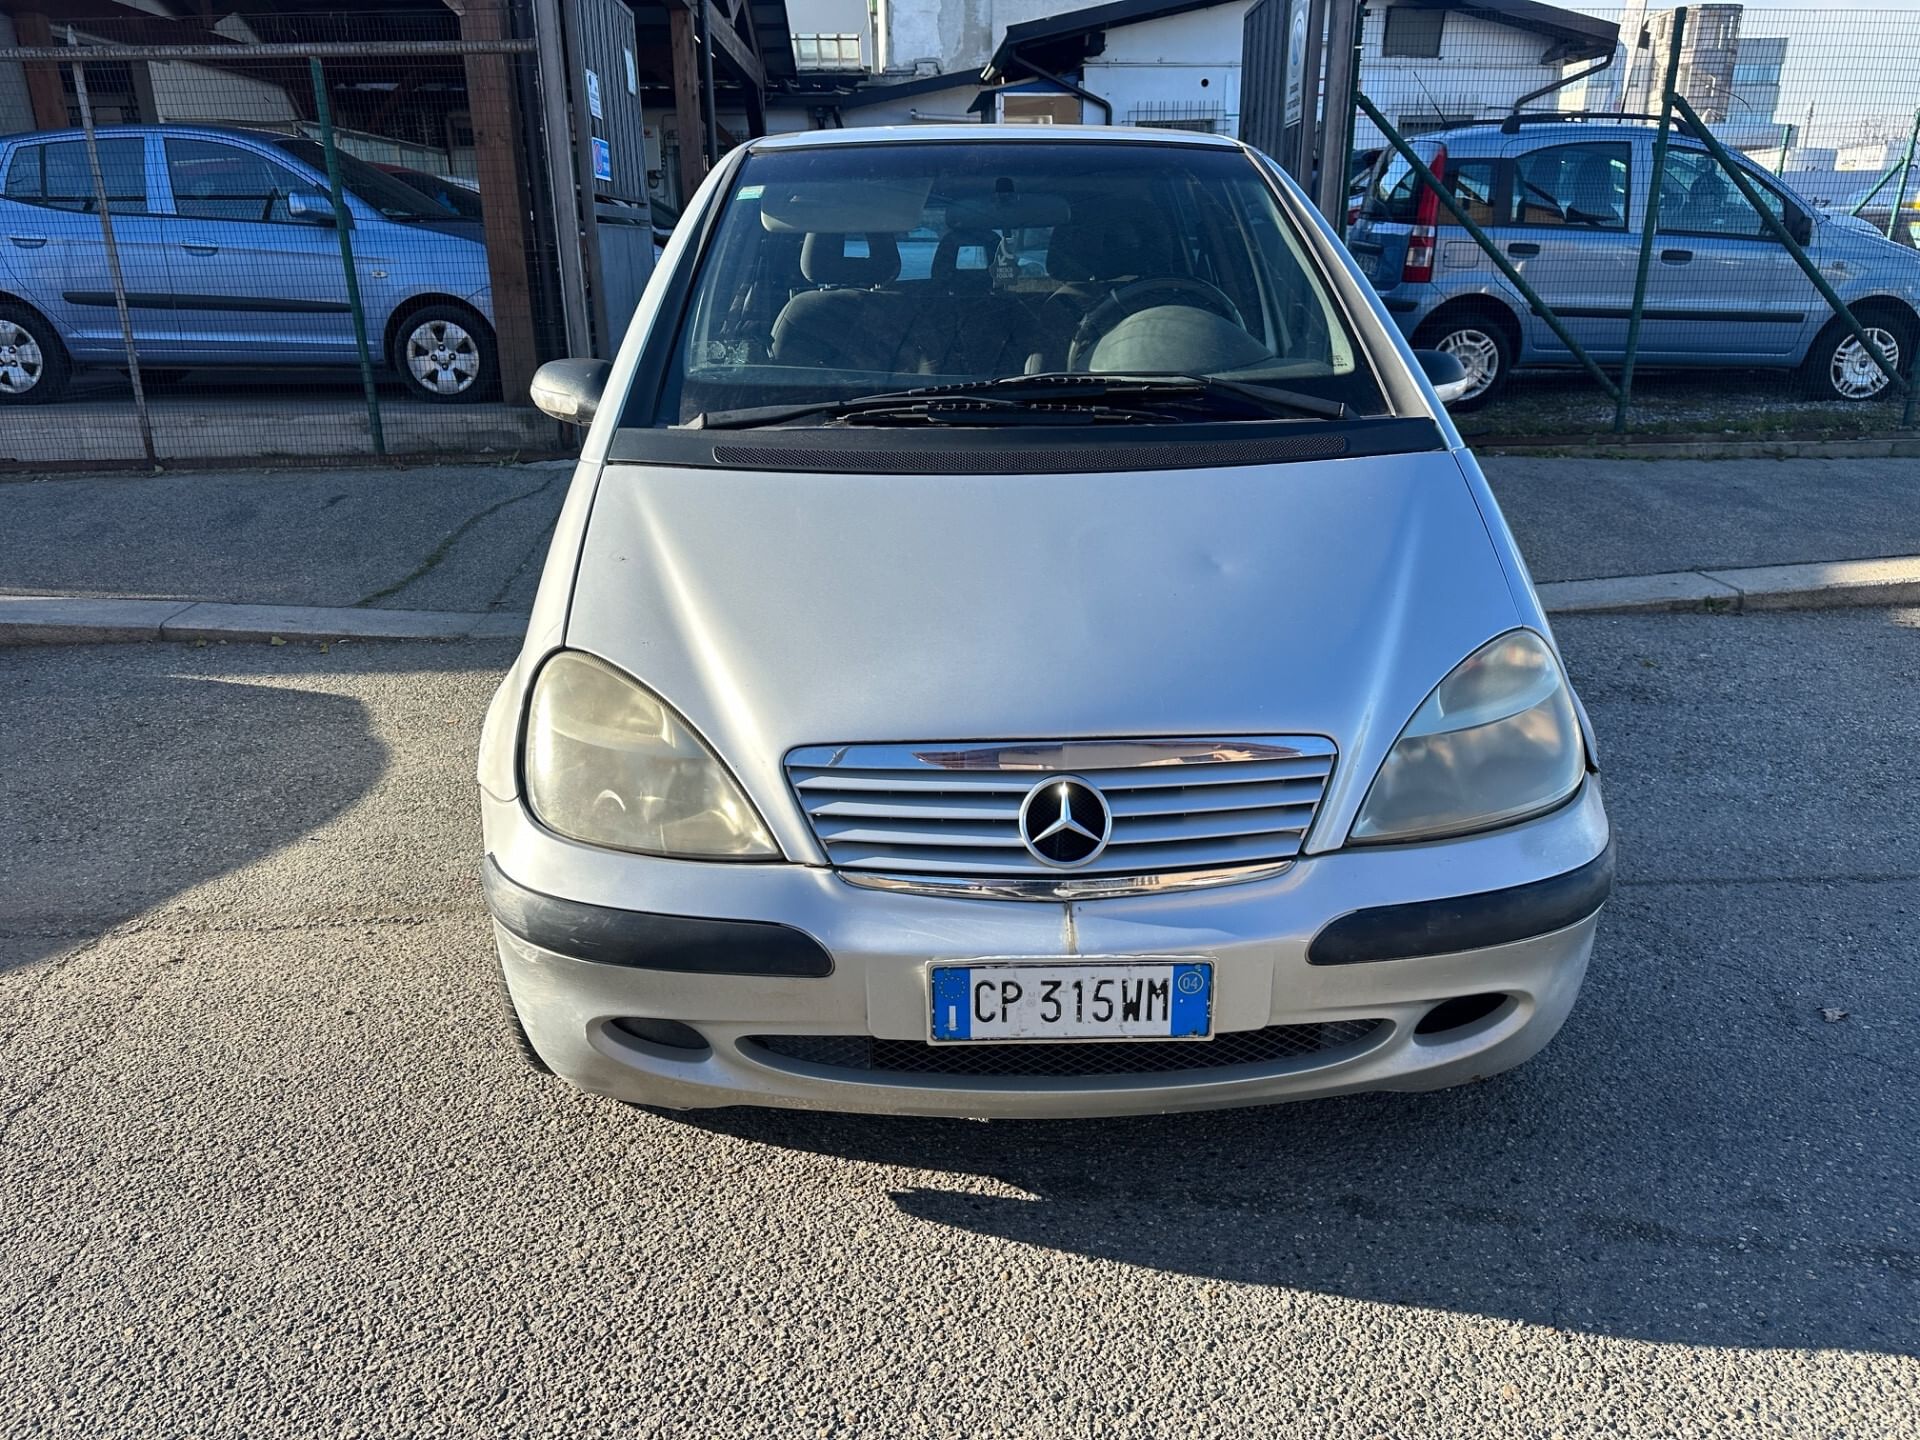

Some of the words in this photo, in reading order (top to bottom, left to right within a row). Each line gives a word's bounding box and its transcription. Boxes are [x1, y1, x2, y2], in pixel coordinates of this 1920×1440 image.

[1182, 976, 1199, 990] 04
[974, 980, 1023, 1023] CP
[1040, 978, 1169, 1023] 315WM
